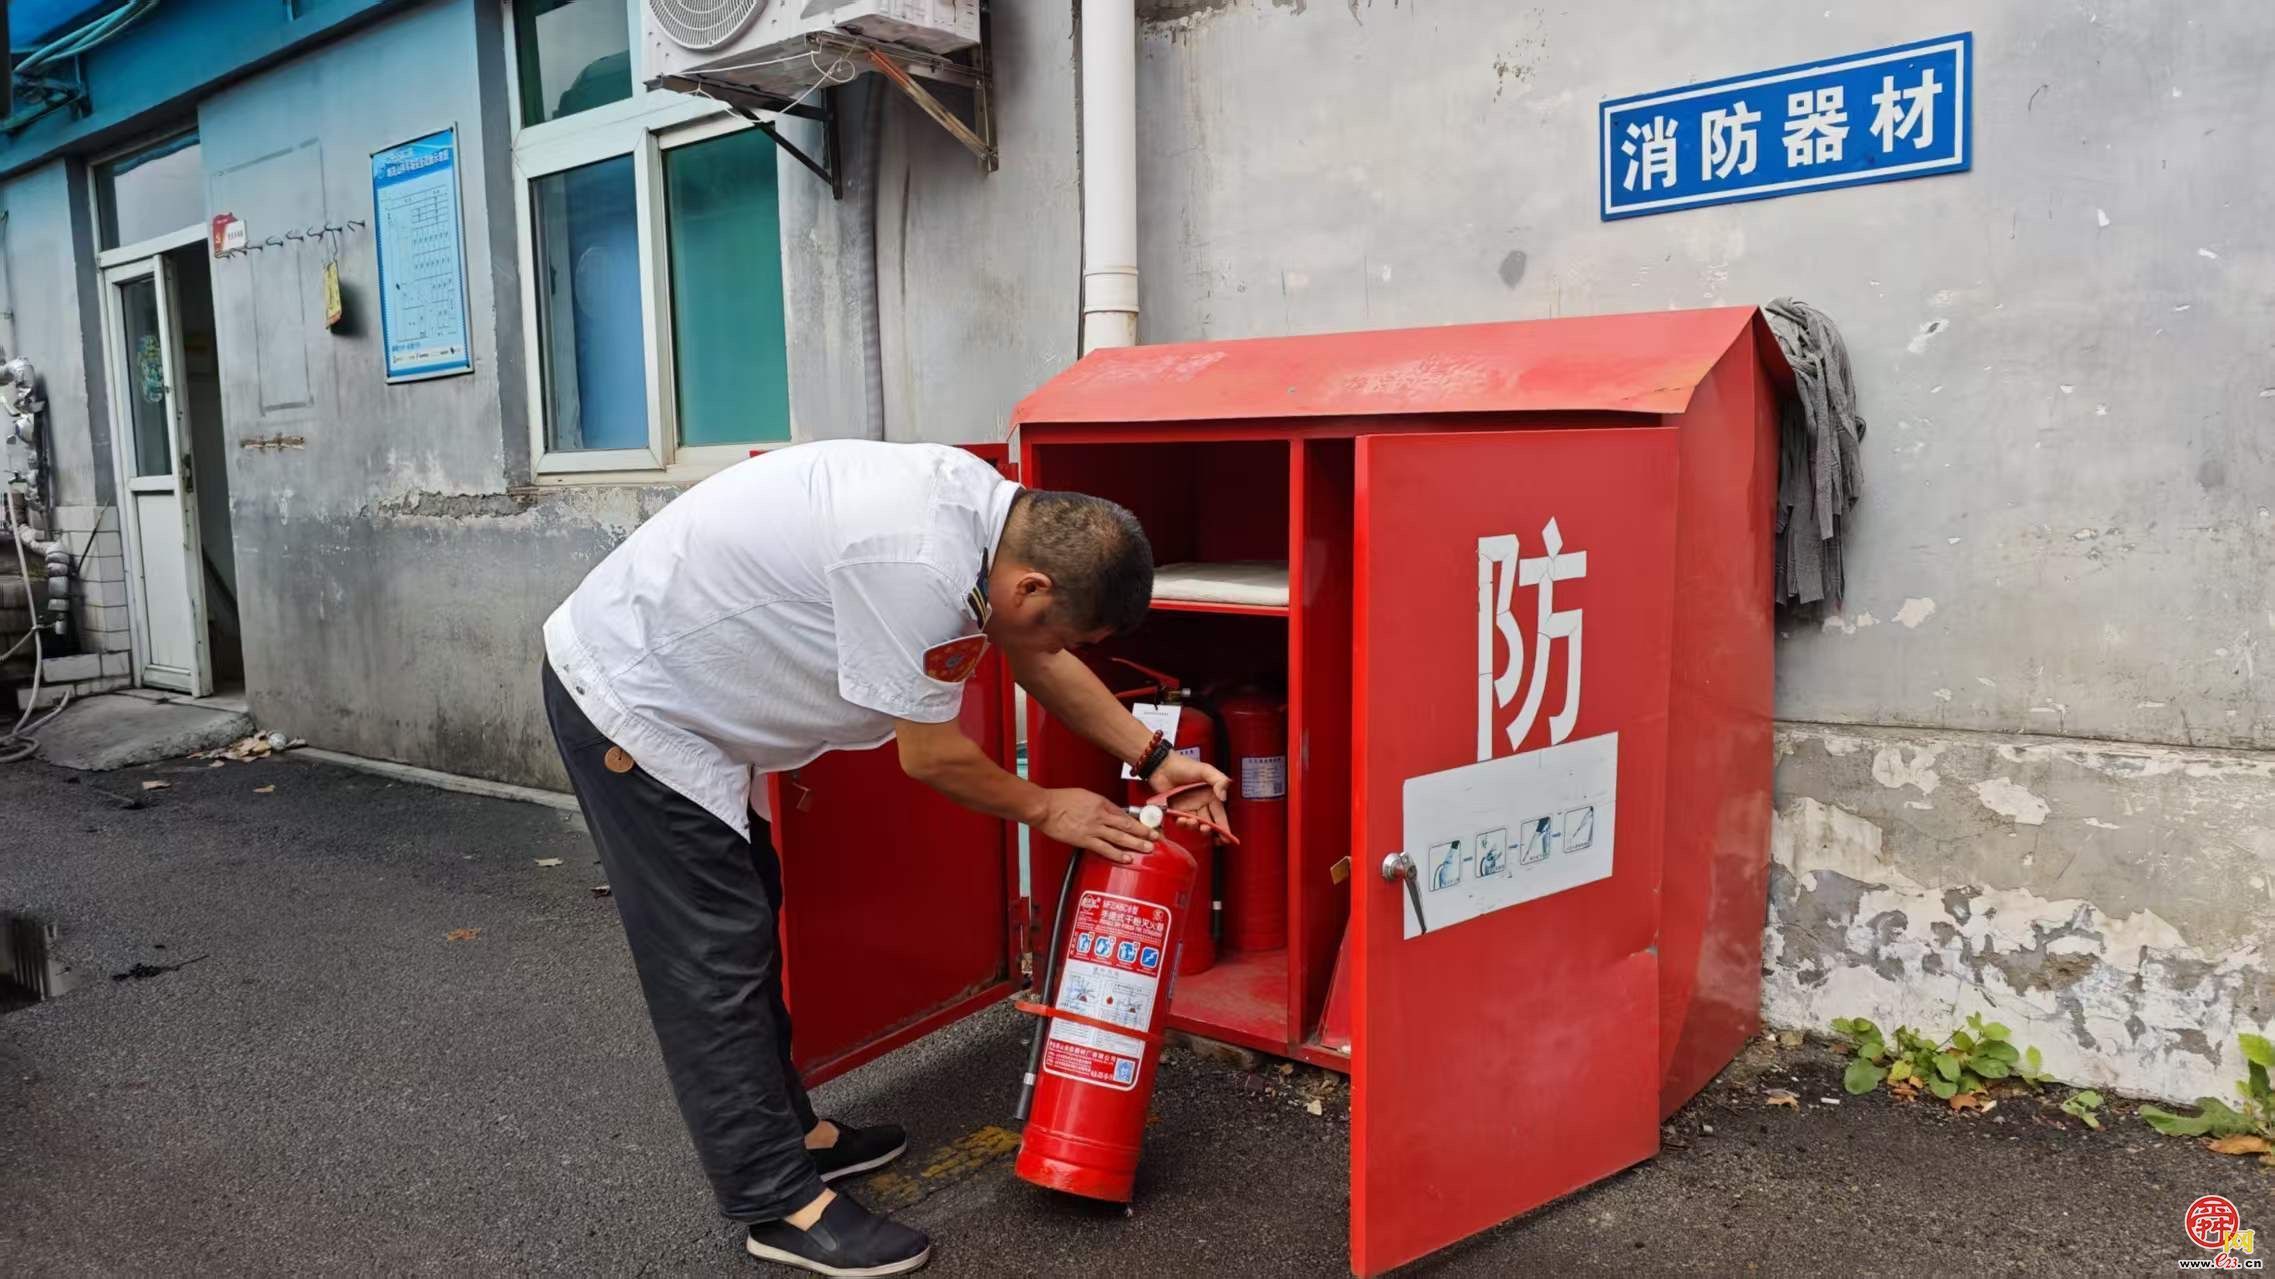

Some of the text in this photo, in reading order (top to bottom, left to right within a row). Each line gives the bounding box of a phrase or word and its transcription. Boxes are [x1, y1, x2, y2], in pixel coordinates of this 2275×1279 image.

[1621, 67, 1943, 192] 消防器材
[1476, 515, 1588, 763] 防
